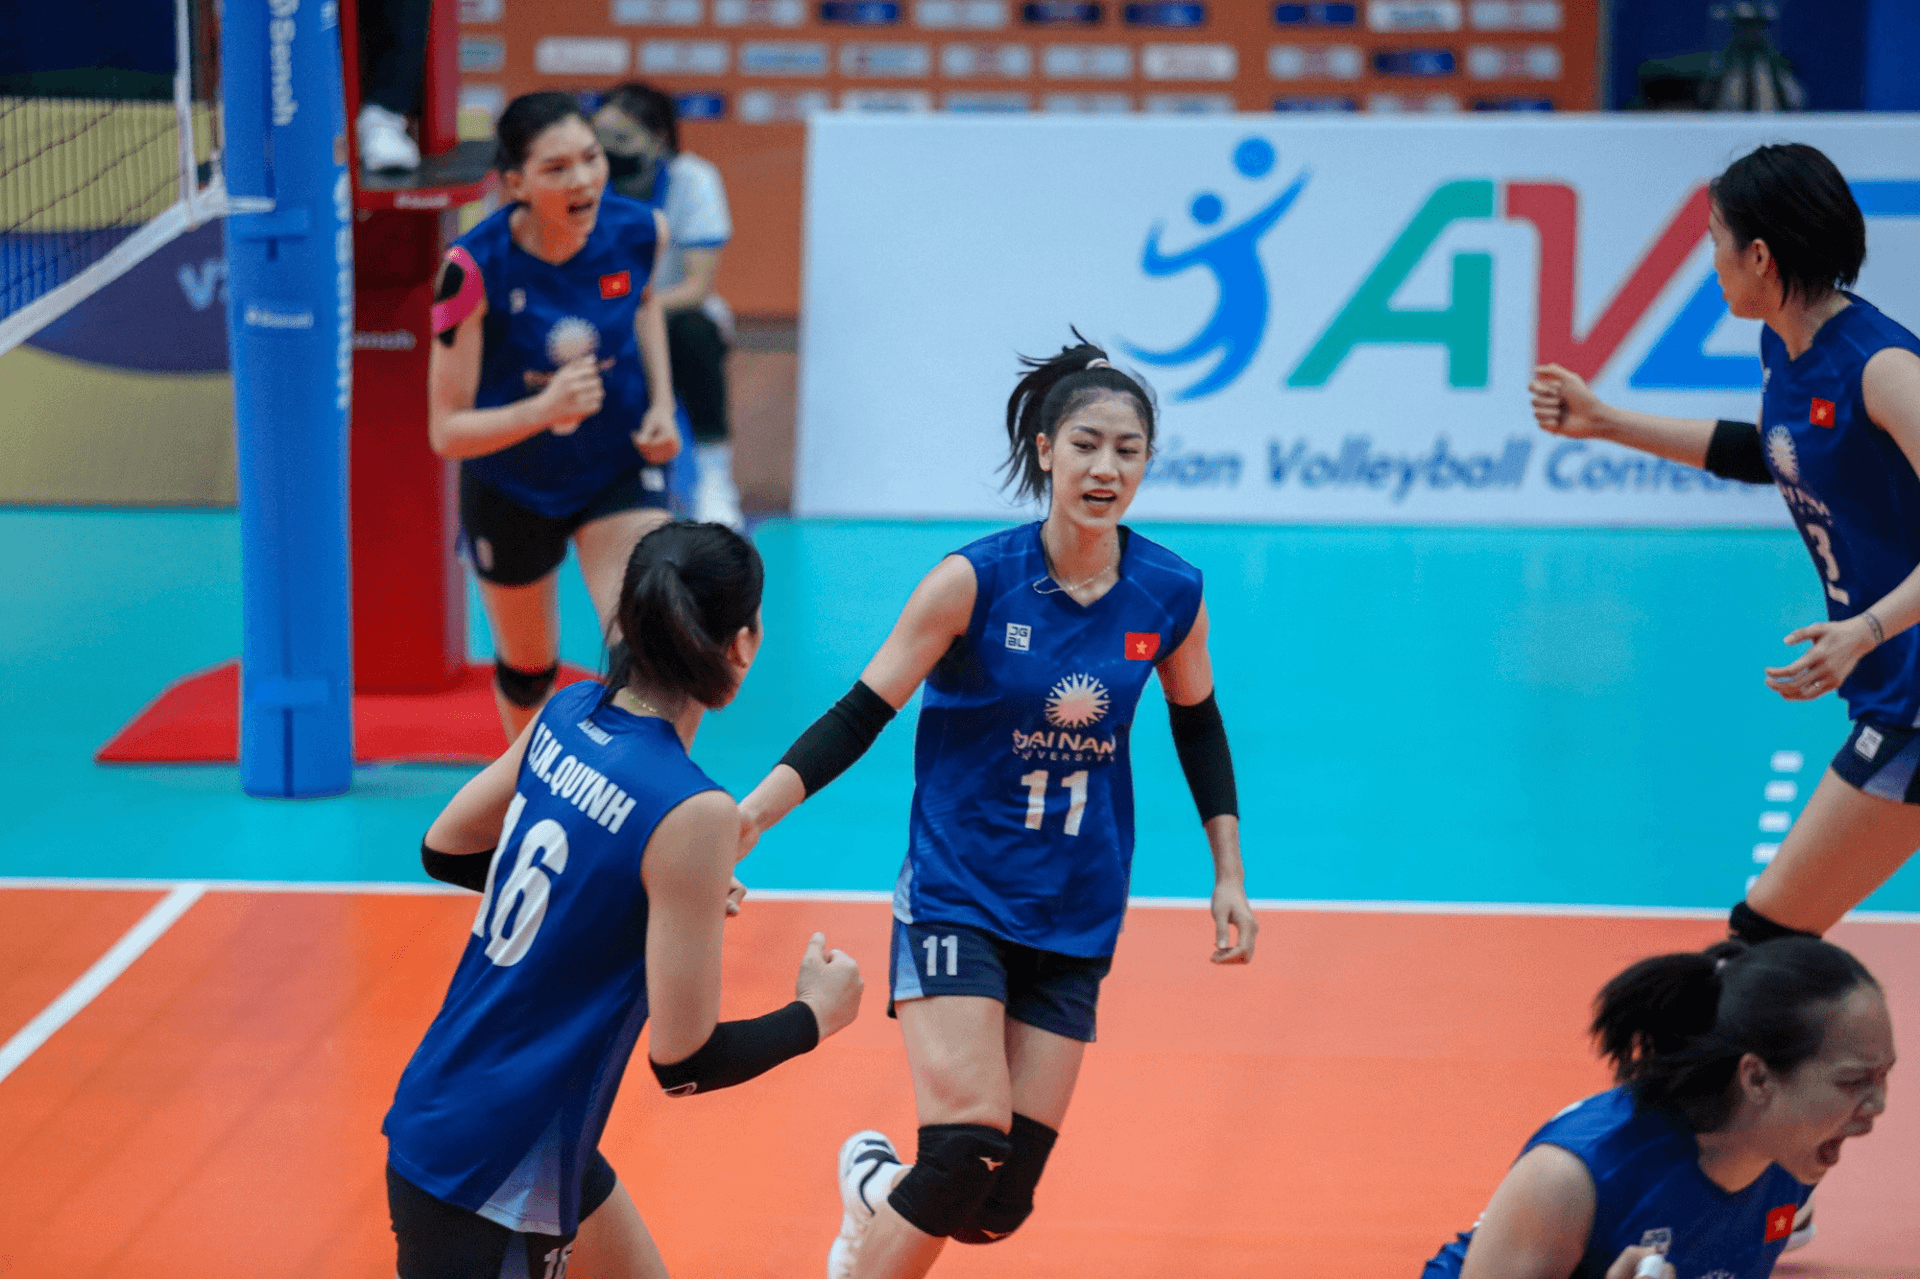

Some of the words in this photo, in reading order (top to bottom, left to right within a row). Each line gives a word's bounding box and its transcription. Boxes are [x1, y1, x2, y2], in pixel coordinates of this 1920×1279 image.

[1144, 434, 1242, 489] sian
[1266, 434, 1532, 504] Volleyball
[1021, 769, 1089, 837] 11
[472, 791, 570, 968] 16
[922, 934, 958, 977] 11
